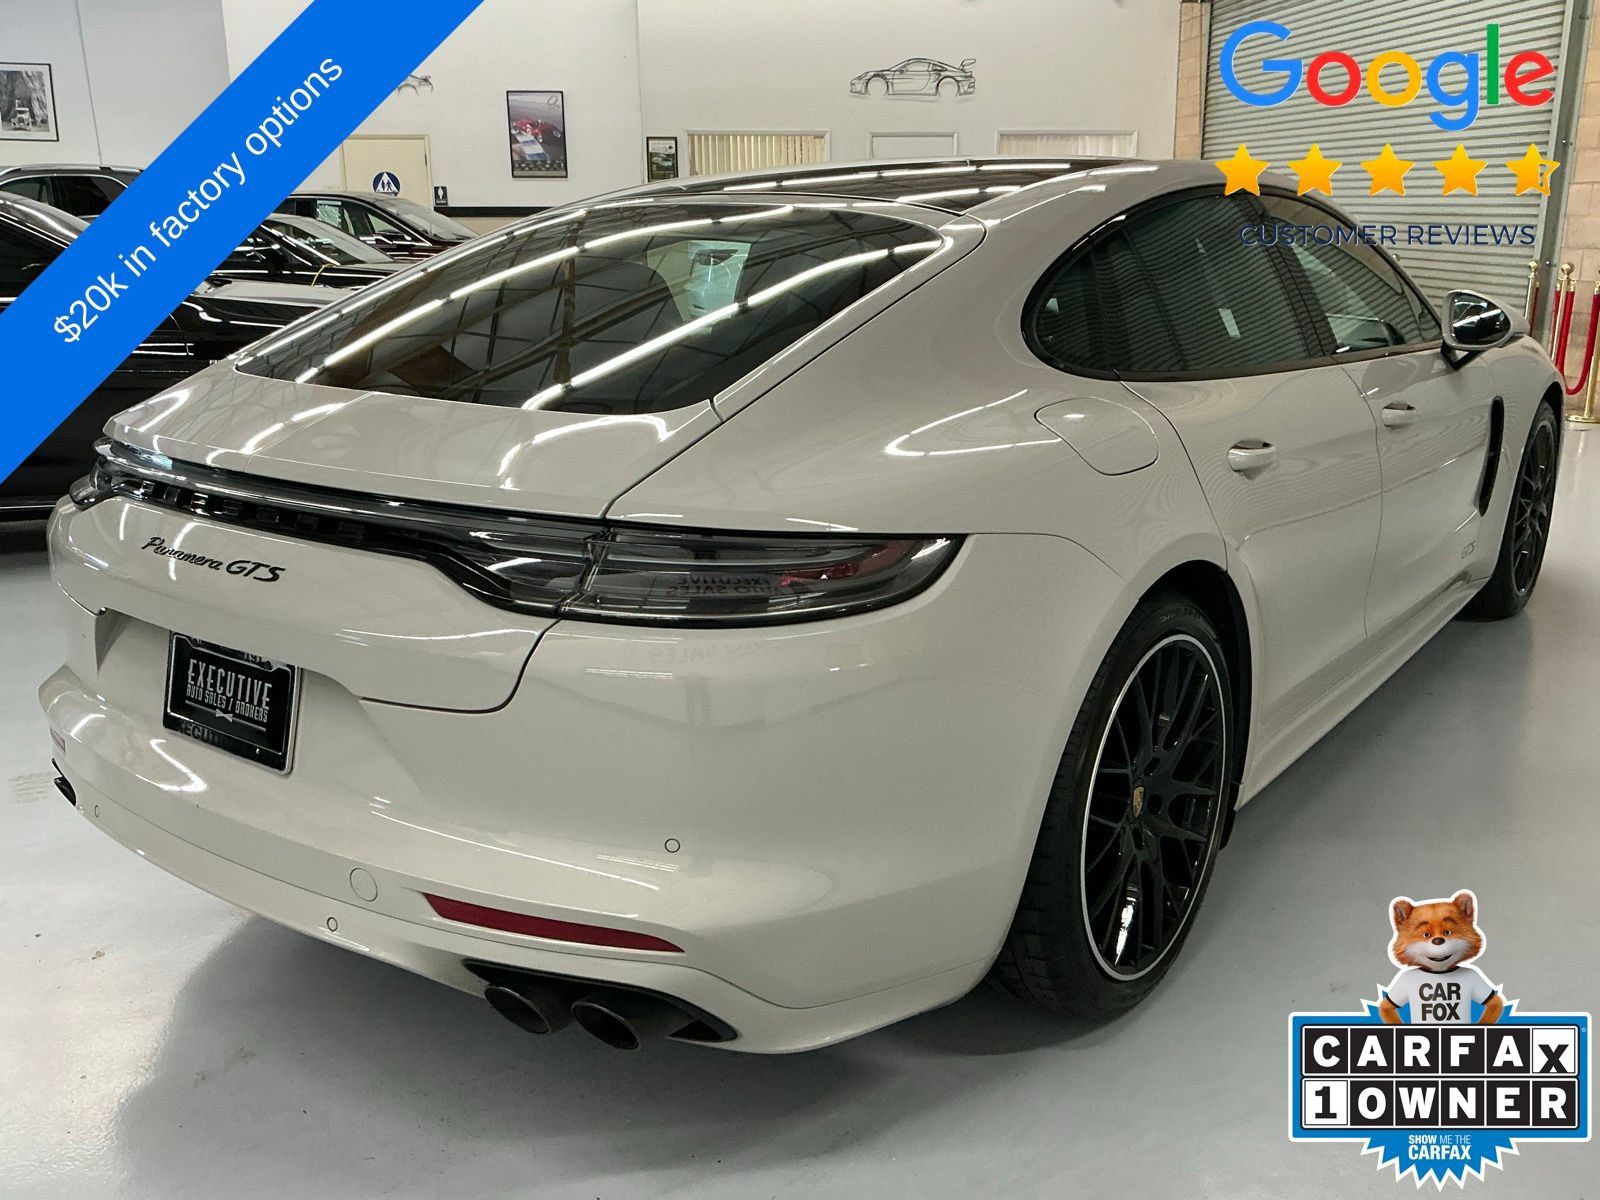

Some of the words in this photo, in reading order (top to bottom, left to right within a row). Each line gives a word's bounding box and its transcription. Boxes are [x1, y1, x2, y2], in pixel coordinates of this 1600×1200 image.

[141, 536, 223, 570] Panamera
[226, 560, 286, 582] GTS
[186, 684, 203, 701] AUTO
[204, 690, 227, 709] SALES
[235, 700, 269, 723] BROKERS
[188, 658, 273, 710] EXECUTIVE
